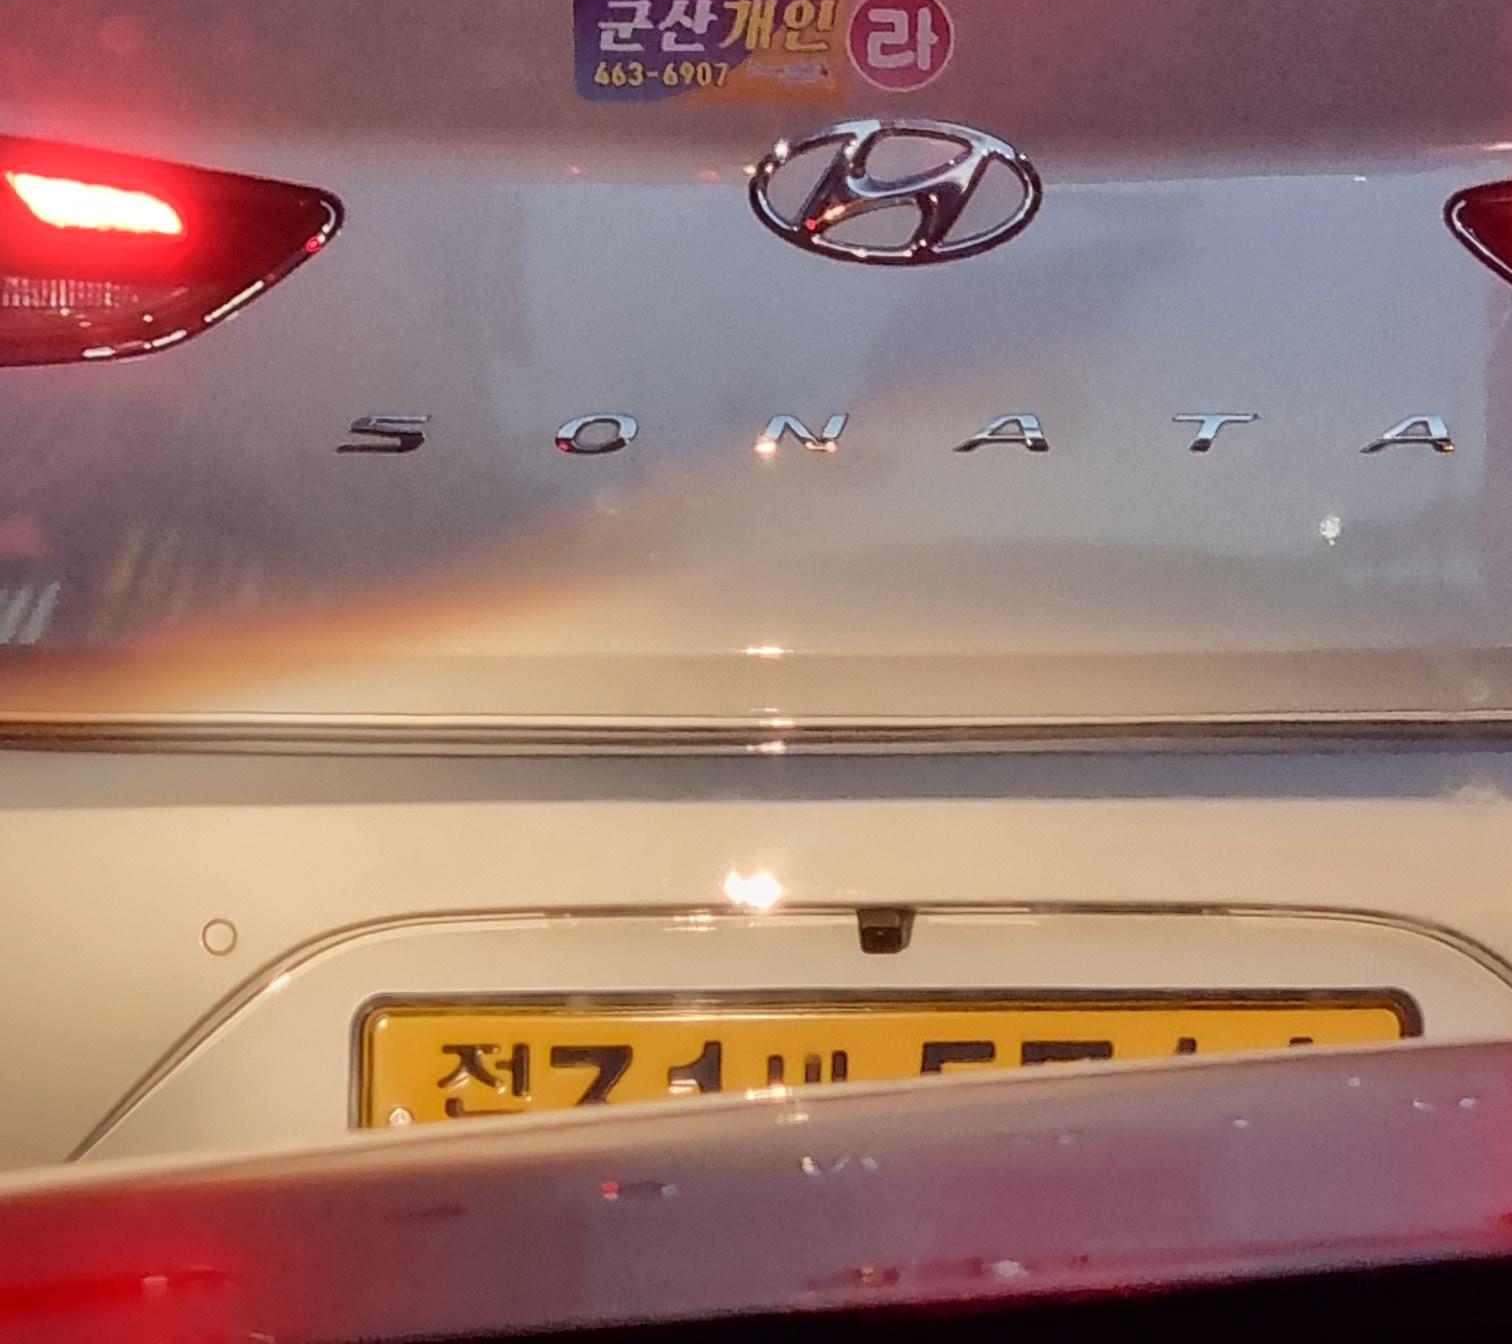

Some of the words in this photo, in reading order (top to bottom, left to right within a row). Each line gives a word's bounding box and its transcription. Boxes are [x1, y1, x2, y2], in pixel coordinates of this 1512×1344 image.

[866, 6, 939, 71] 라
[594, 61, 729, 87] 663-6907
[335, 412, 1455, 455] SONATA
